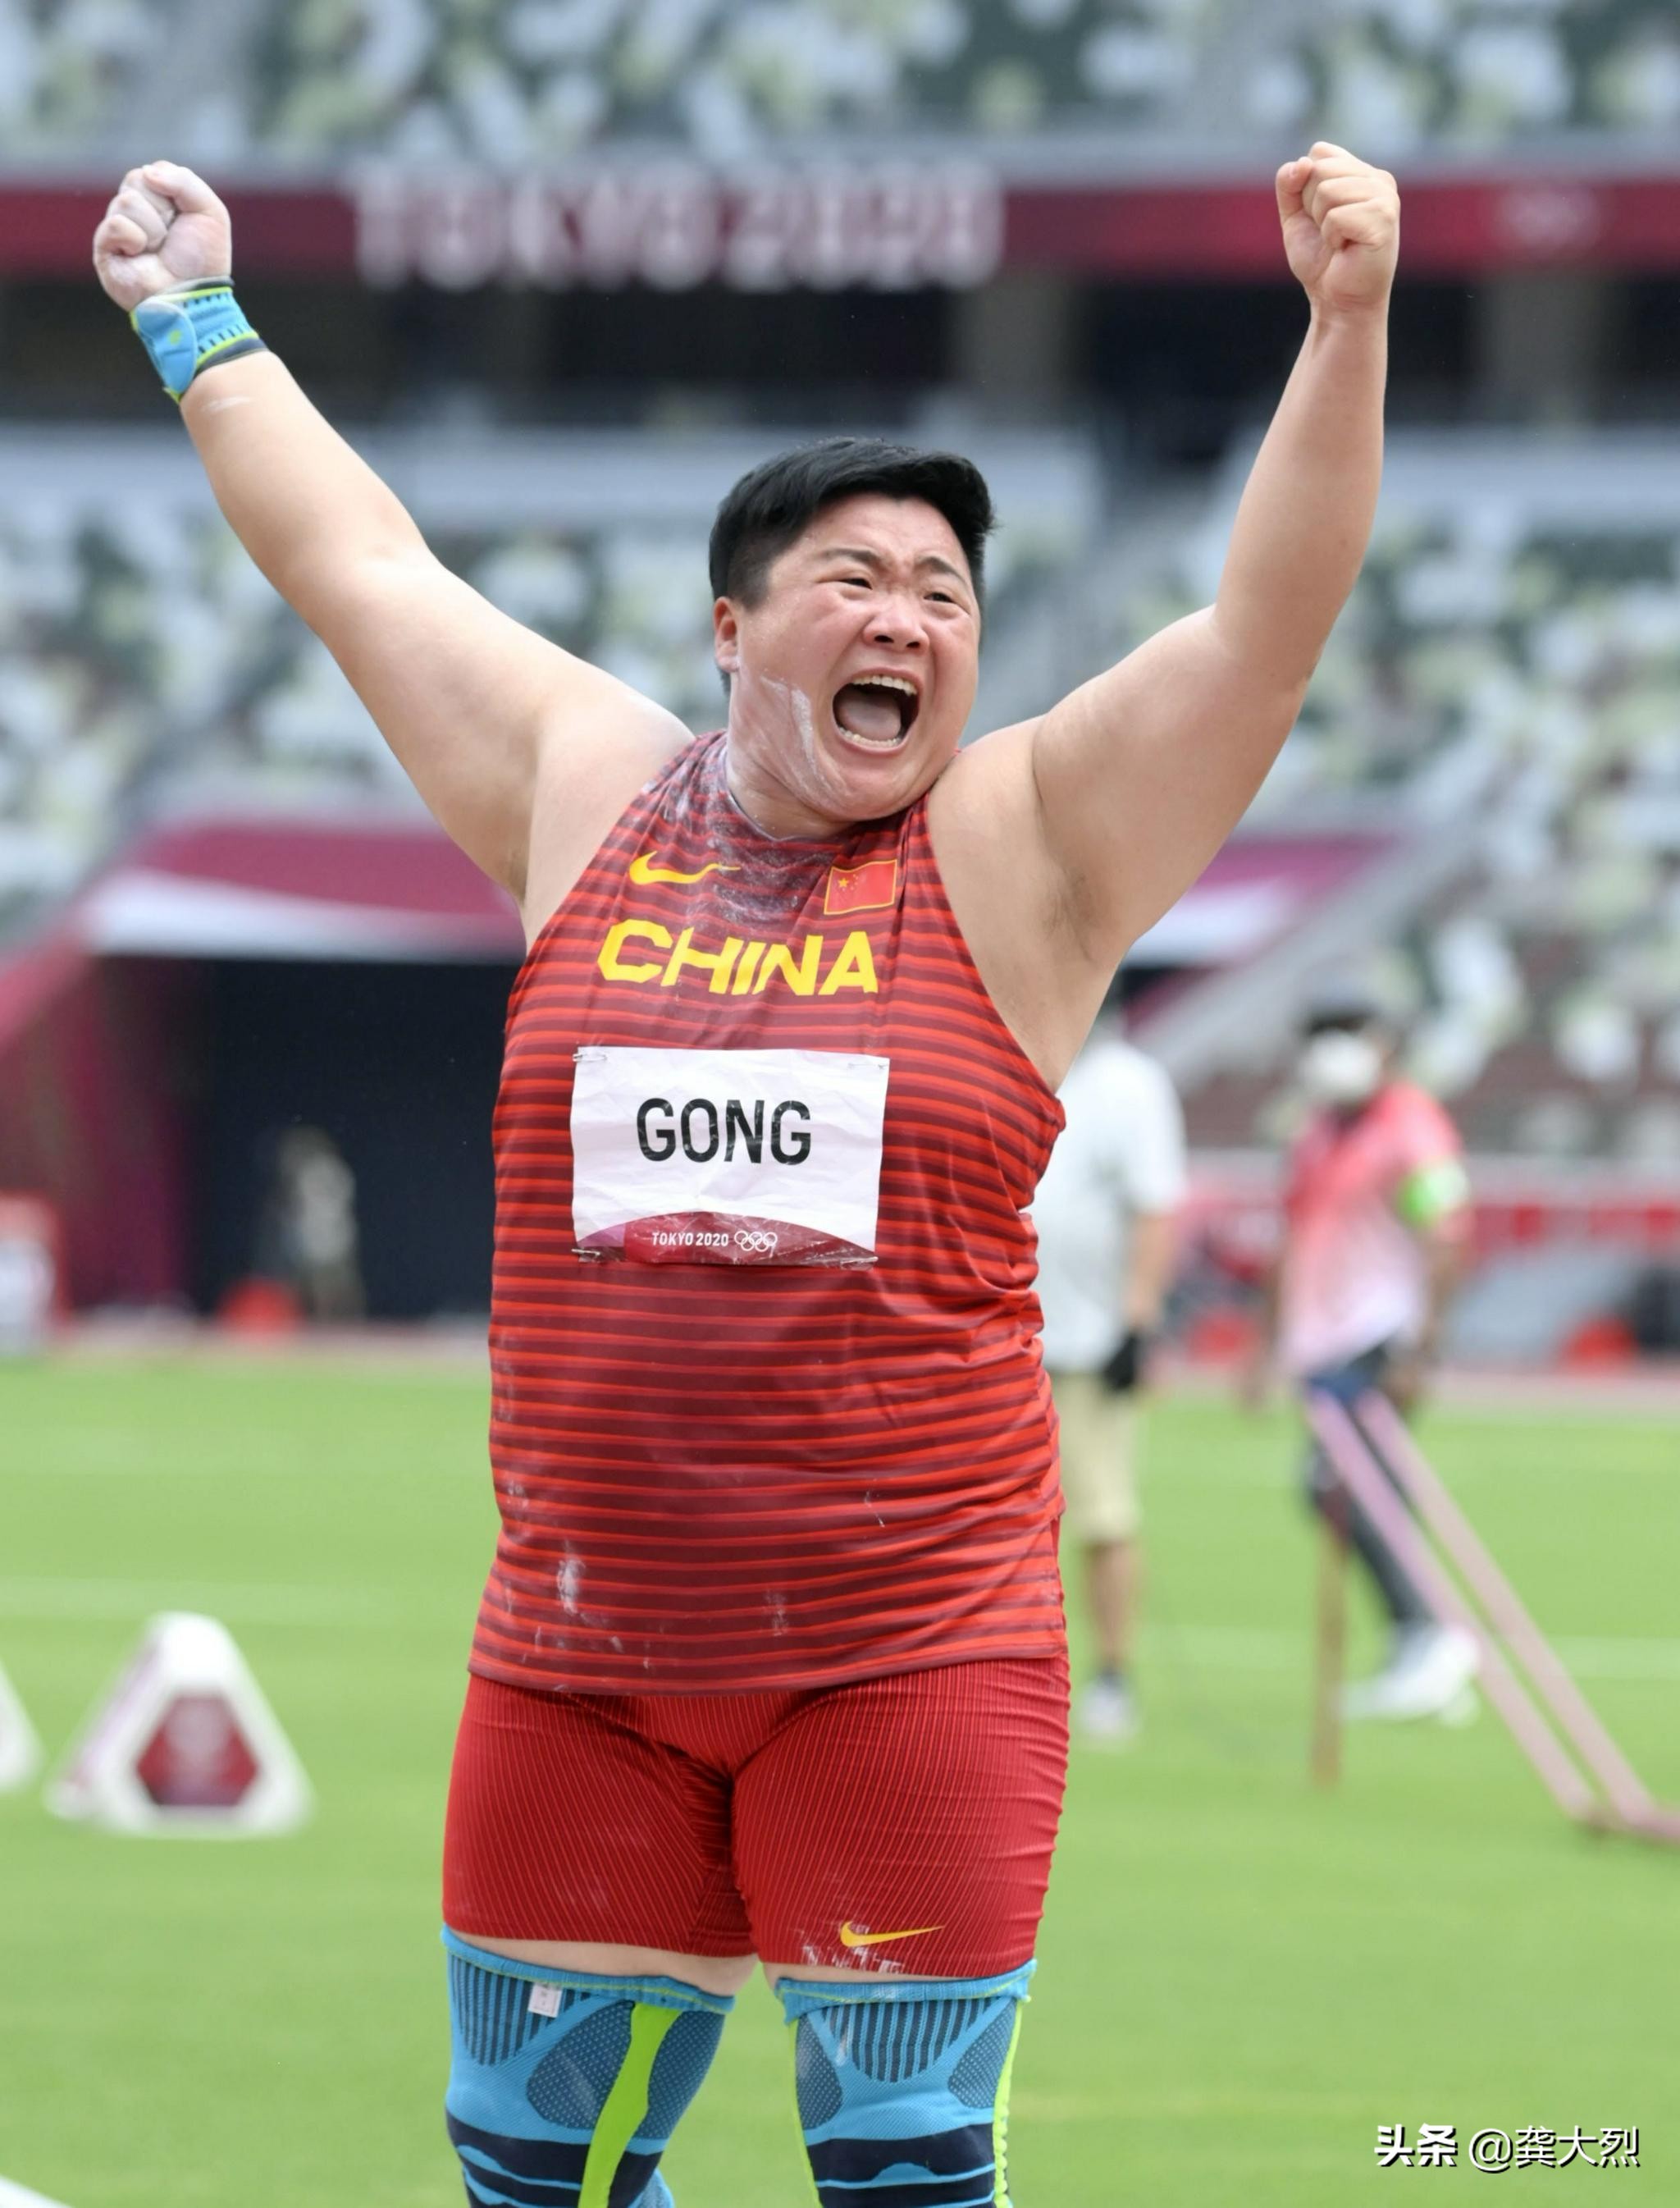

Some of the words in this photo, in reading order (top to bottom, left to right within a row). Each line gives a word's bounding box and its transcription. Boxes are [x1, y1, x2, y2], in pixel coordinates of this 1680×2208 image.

[596, 918, 879, 996] CHINA
[636, 1098, 811, 1165] GONG
[651, 1231, 694, 1246] TOKYO
[696, 1232, 729, 1247] 2020
